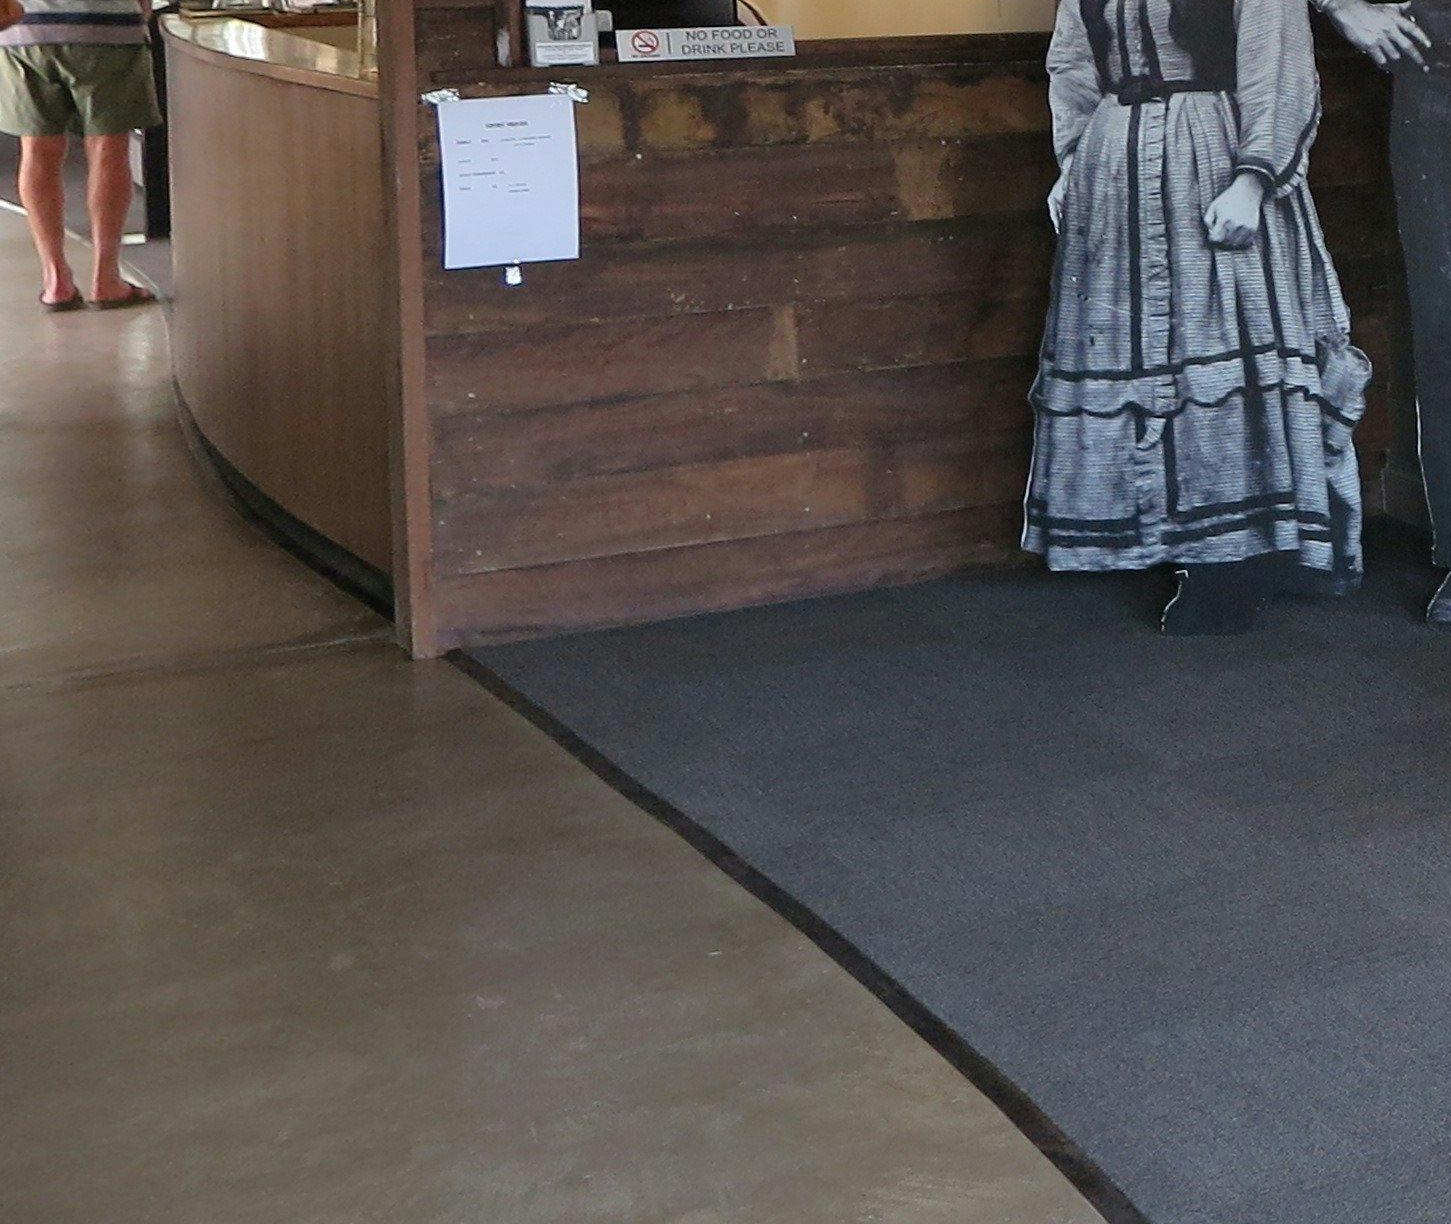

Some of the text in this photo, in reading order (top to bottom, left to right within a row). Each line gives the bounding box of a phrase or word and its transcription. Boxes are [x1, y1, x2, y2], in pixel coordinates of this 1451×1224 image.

[686, 28, 778, 41] NO FOOD OR
[681, 41, 785, 55] DRINK PLEASE
